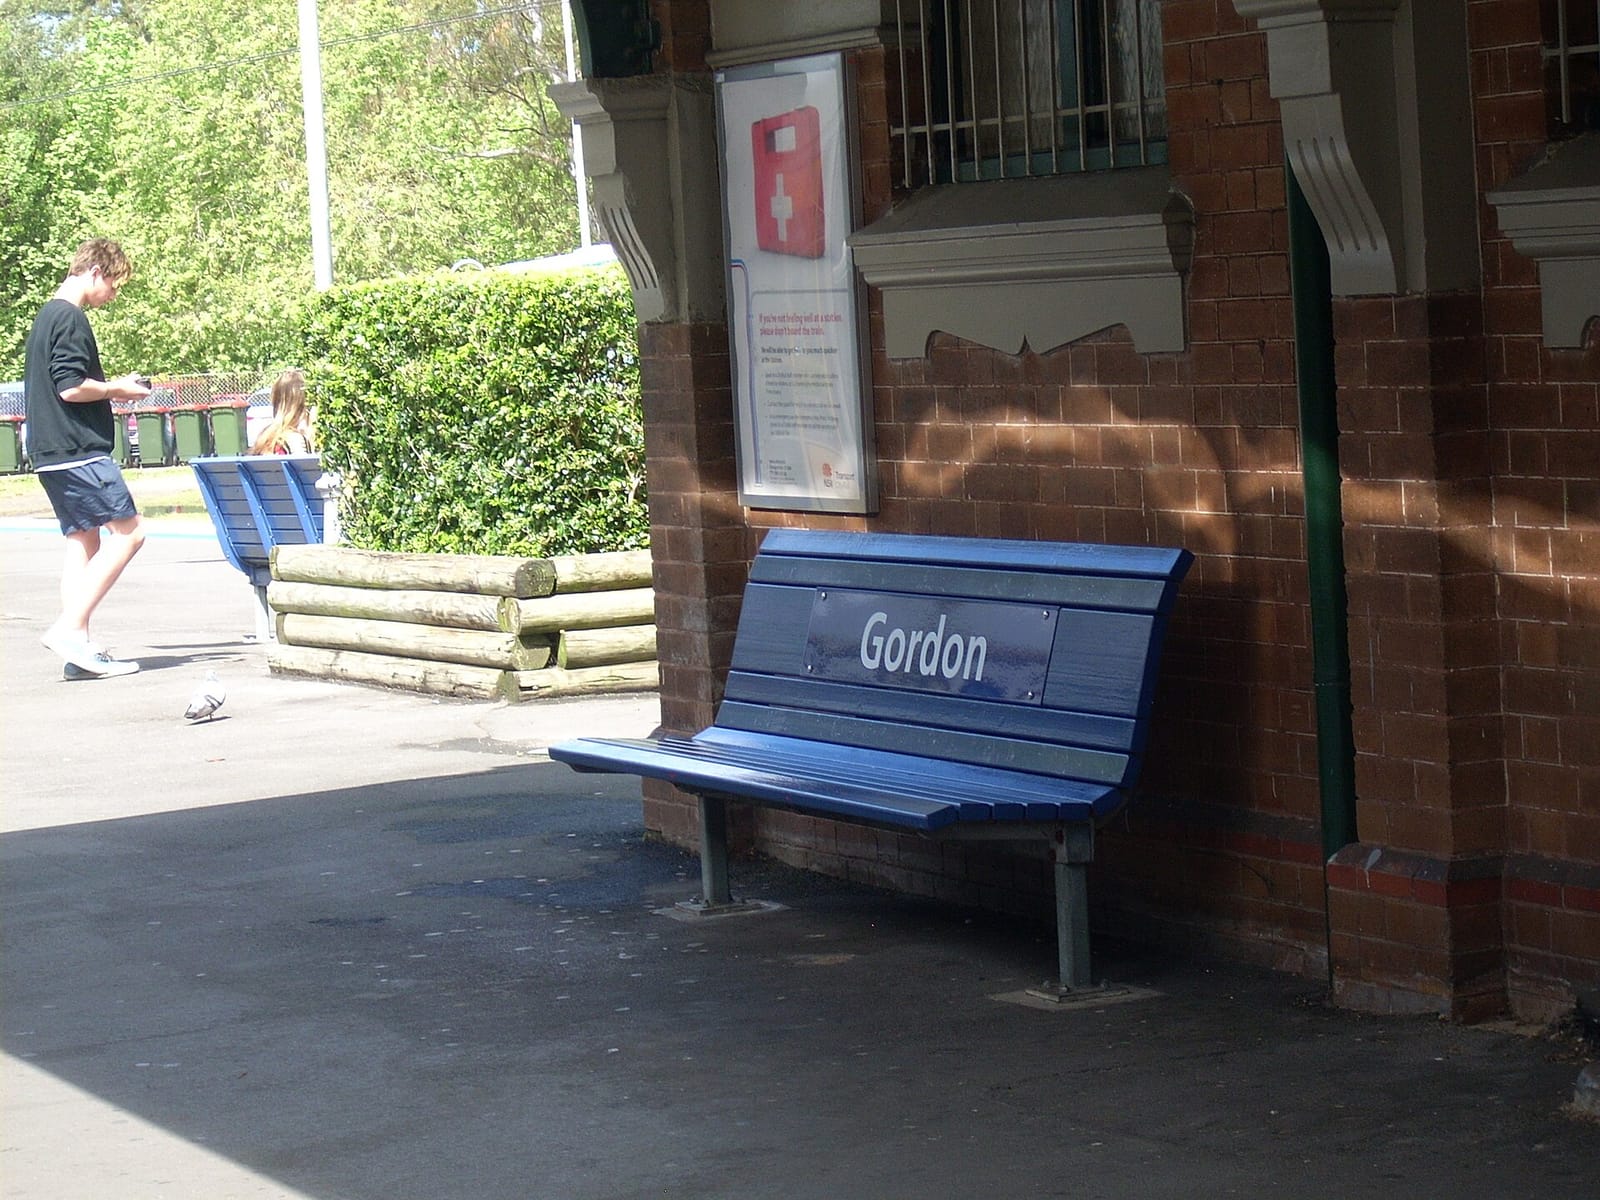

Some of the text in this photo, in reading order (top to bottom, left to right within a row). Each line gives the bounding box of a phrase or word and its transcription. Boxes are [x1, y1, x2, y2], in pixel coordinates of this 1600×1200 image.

[763, 314, 776, 325] you're
[777, 314, 785, 322] not
[785, 313, 802, 325] feeling
[803, 313, 814, 322] well
[860, 611, 987, 682] Gordon
